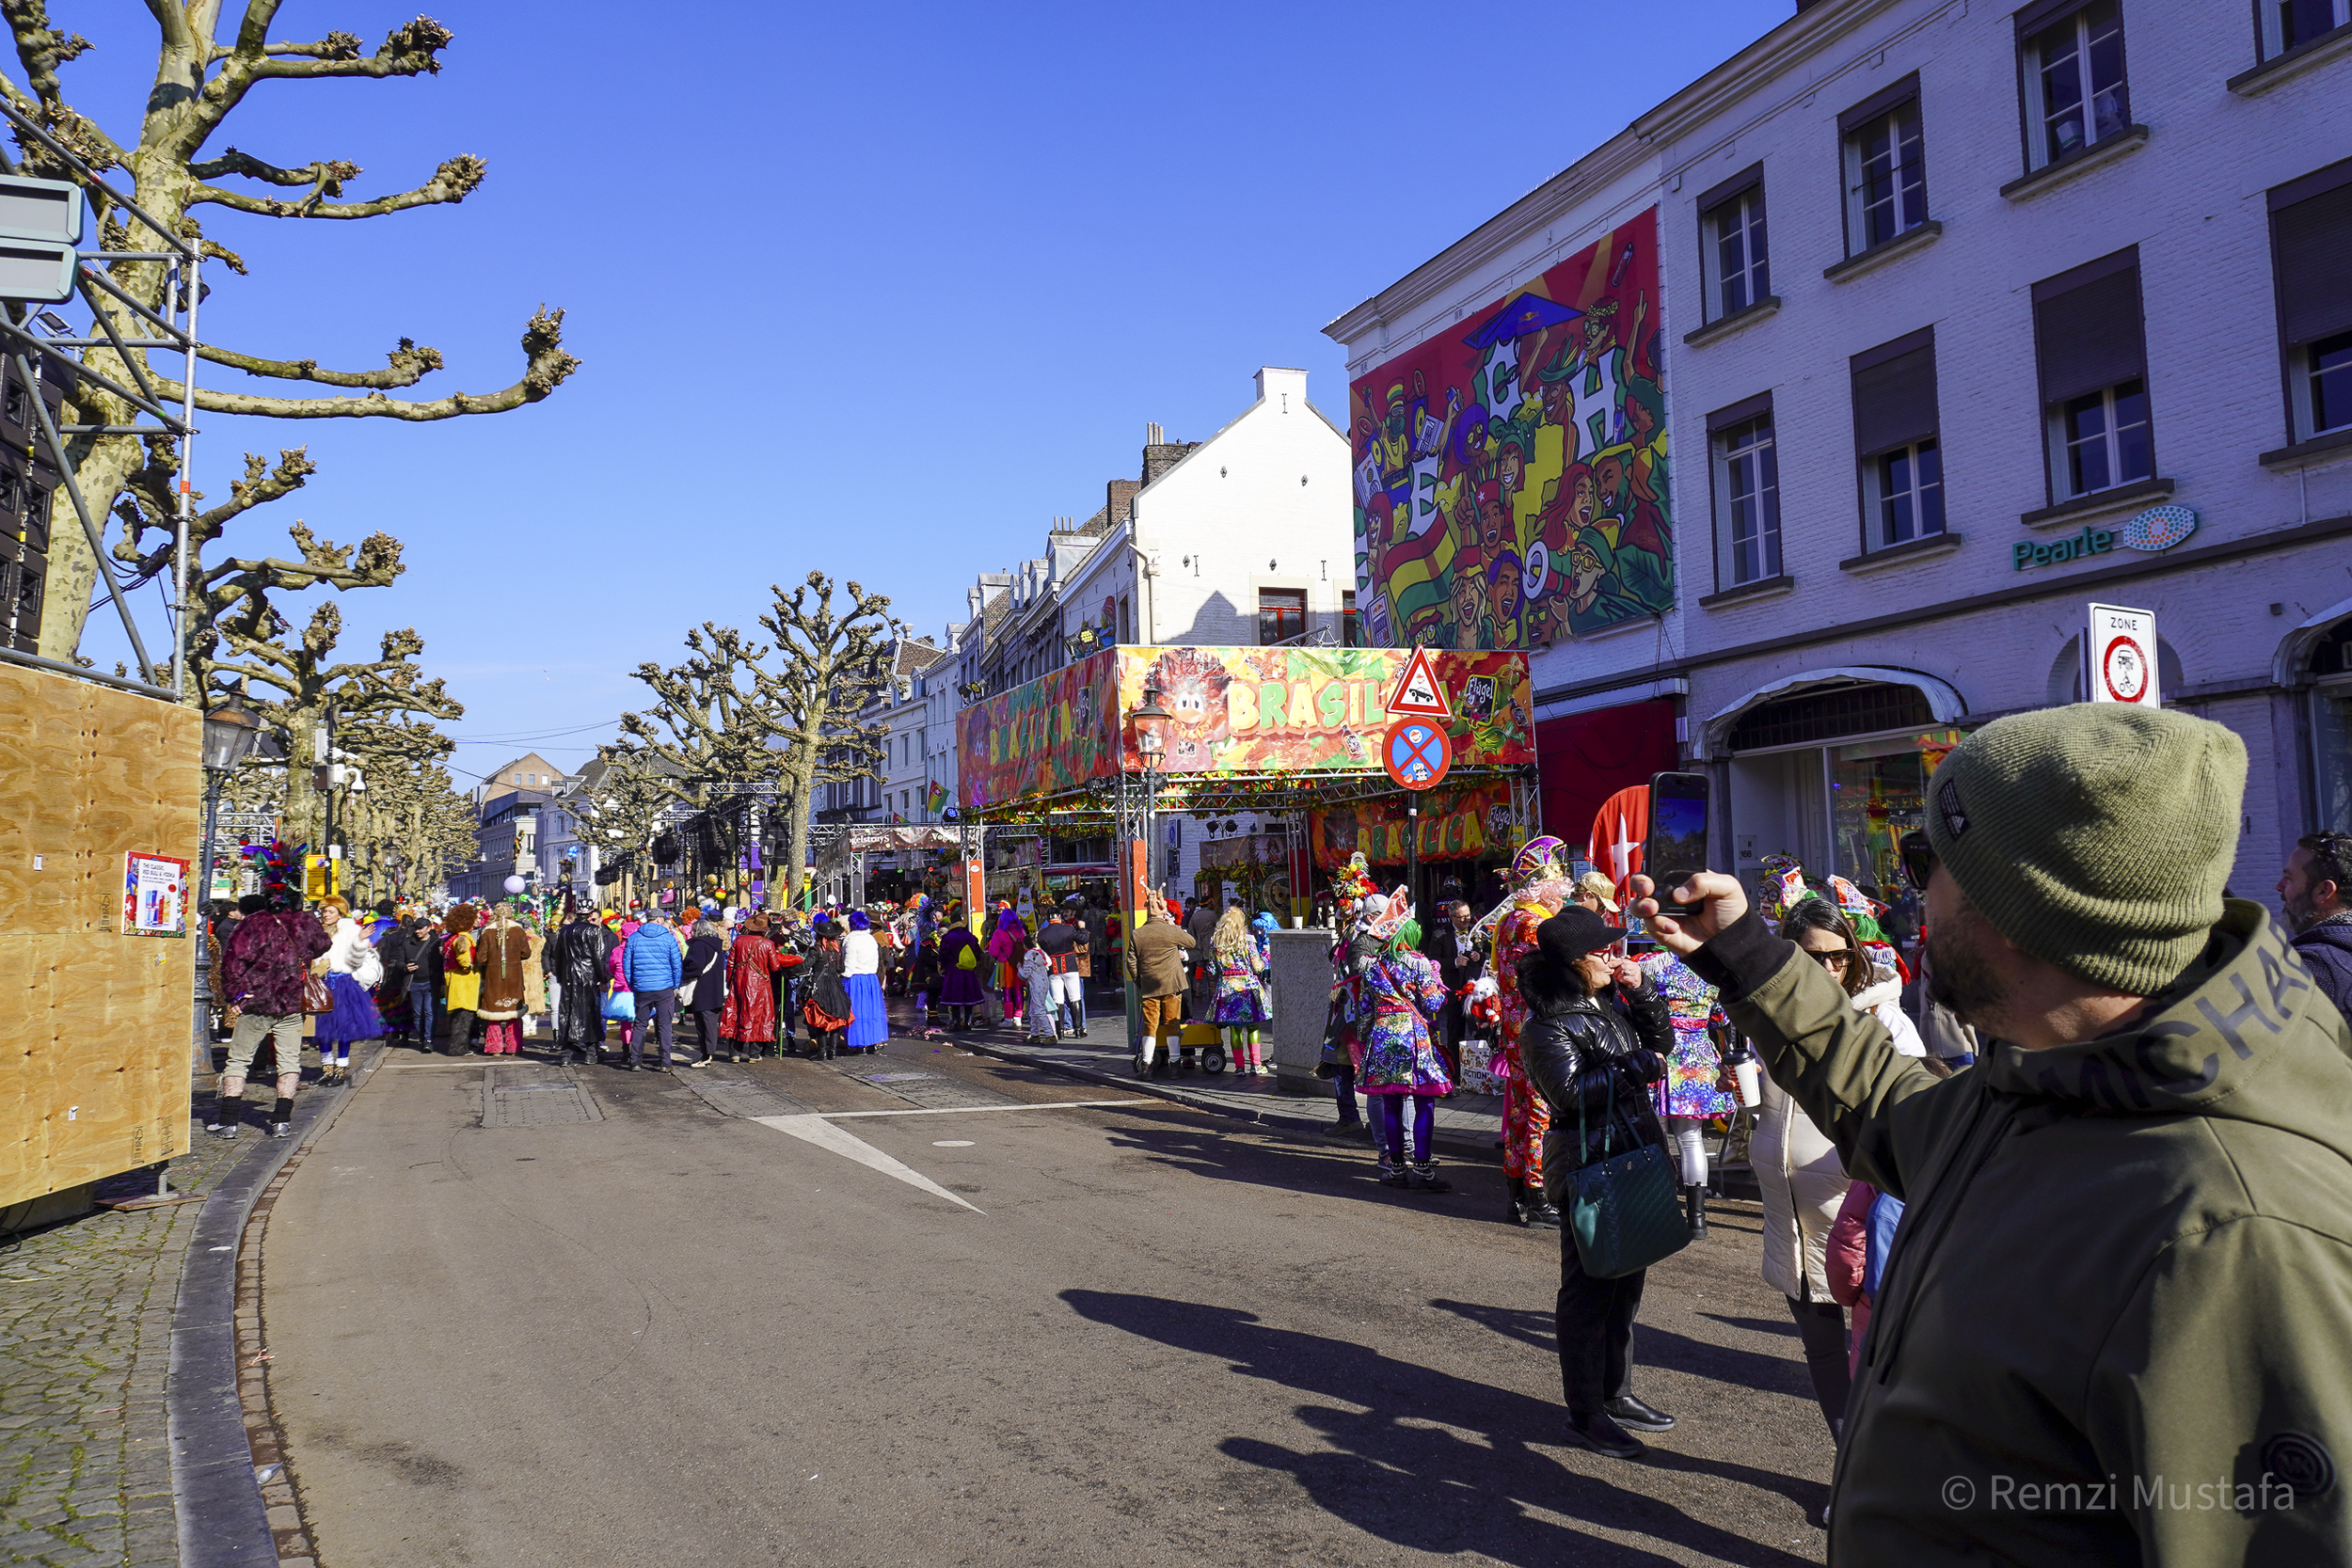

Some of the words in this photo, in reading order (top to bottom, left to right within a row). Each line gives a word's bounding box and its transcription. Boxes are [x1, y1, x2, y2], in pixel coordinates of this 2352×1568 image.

[2012, 526, 2114, 571] Pearle
[2110, 617, 2138, 631] ZONE
[1464, 676, 1494, 704] Flügel
[990, 700, 1072, 767] BRASILICA
